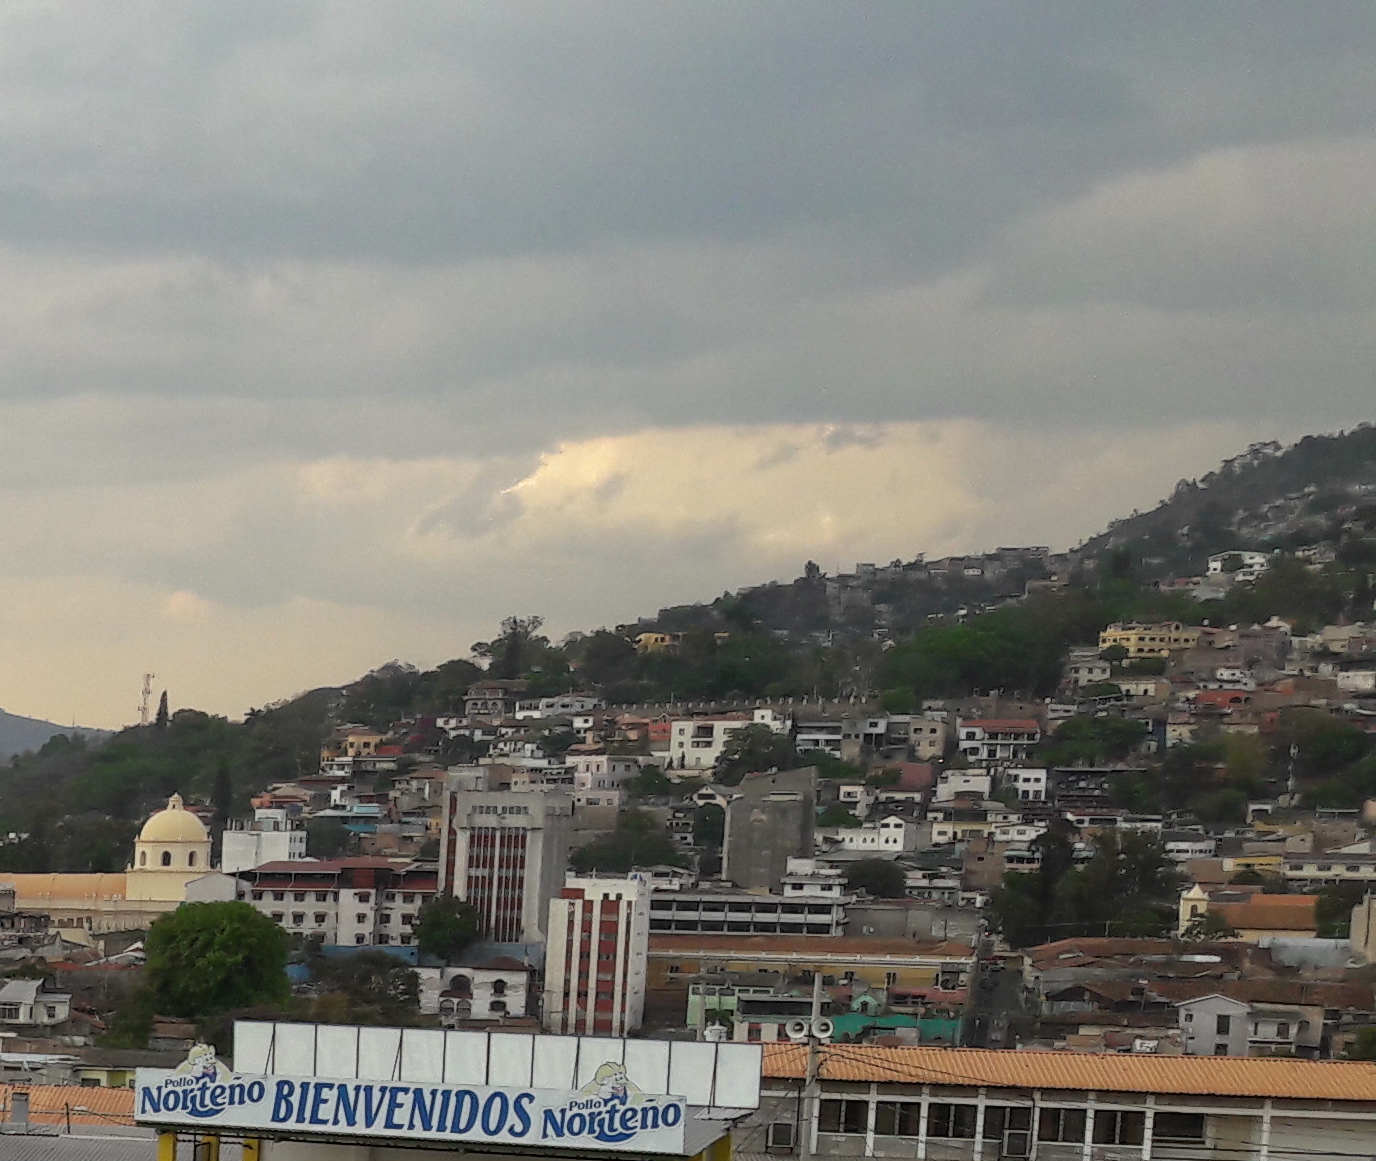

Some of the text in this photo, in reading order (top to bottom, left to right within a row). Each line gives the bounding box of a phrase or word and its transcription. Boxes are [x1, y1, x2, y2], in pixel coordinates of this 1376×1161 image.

[141, 1077, 265, 1118] Norteño
[165, 1077, 193, 1089] Pollo
[270, 1079, 536, 1138] BIENVENIDOS
[541, 1099, 681, 1143] Norteño
[569, 1099, 601, 1112] Pollo
